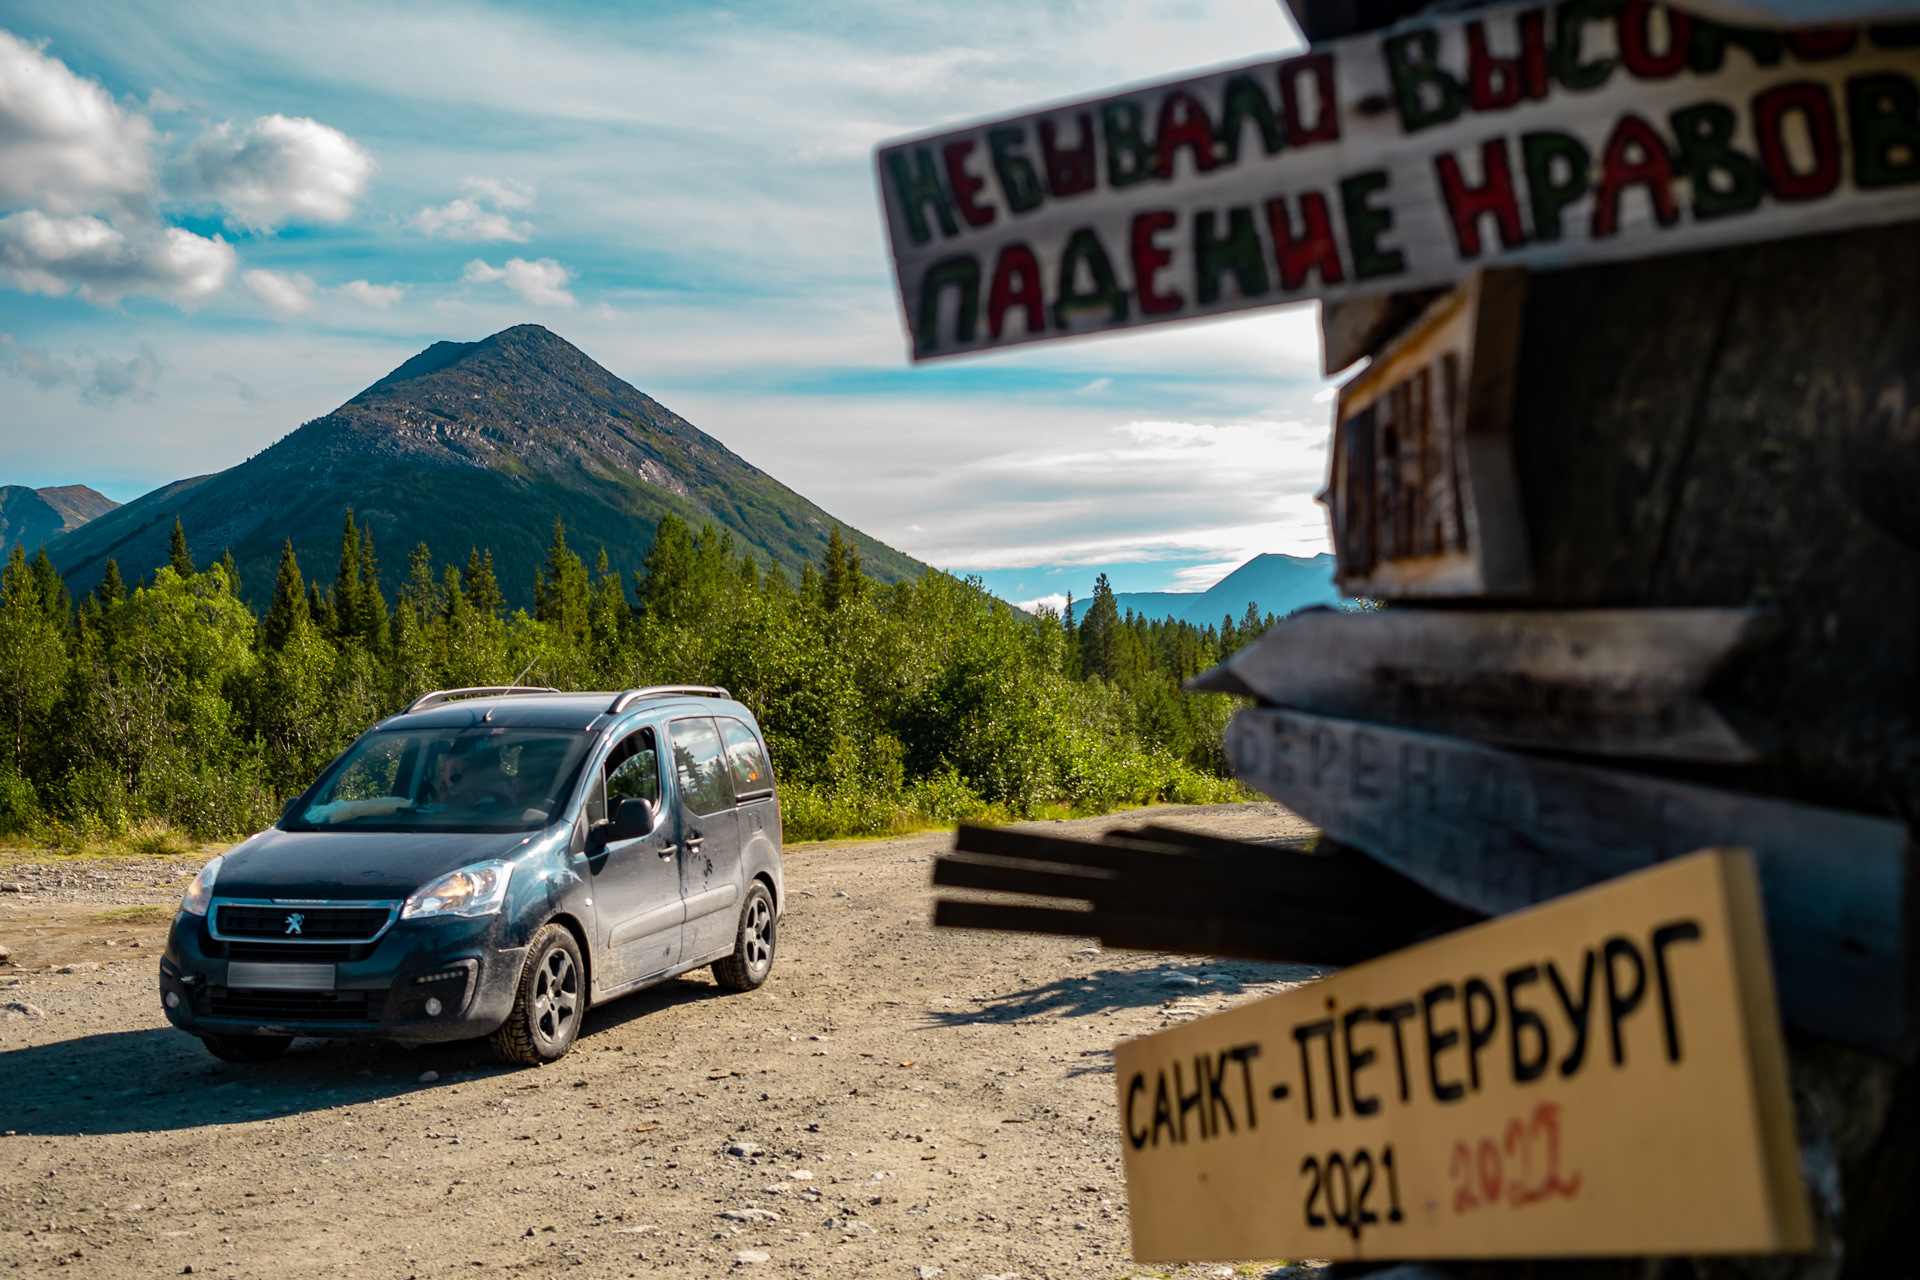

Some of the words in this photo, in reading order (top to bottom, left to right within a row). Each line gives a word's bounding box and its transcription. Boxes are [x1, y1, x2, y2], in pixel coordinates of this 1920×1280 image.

[917, 168, 1406, 354] ПАДЕНИЕ
[1434, 71, 1920, 259] НРАВОВ
[1125, 918, 1704, 1151] САНКТ-ПЕТЕРБУРГ
[1301, 1143, 1406, 1229] 2021
[1448, 1100, 1584, 1216] 2022
